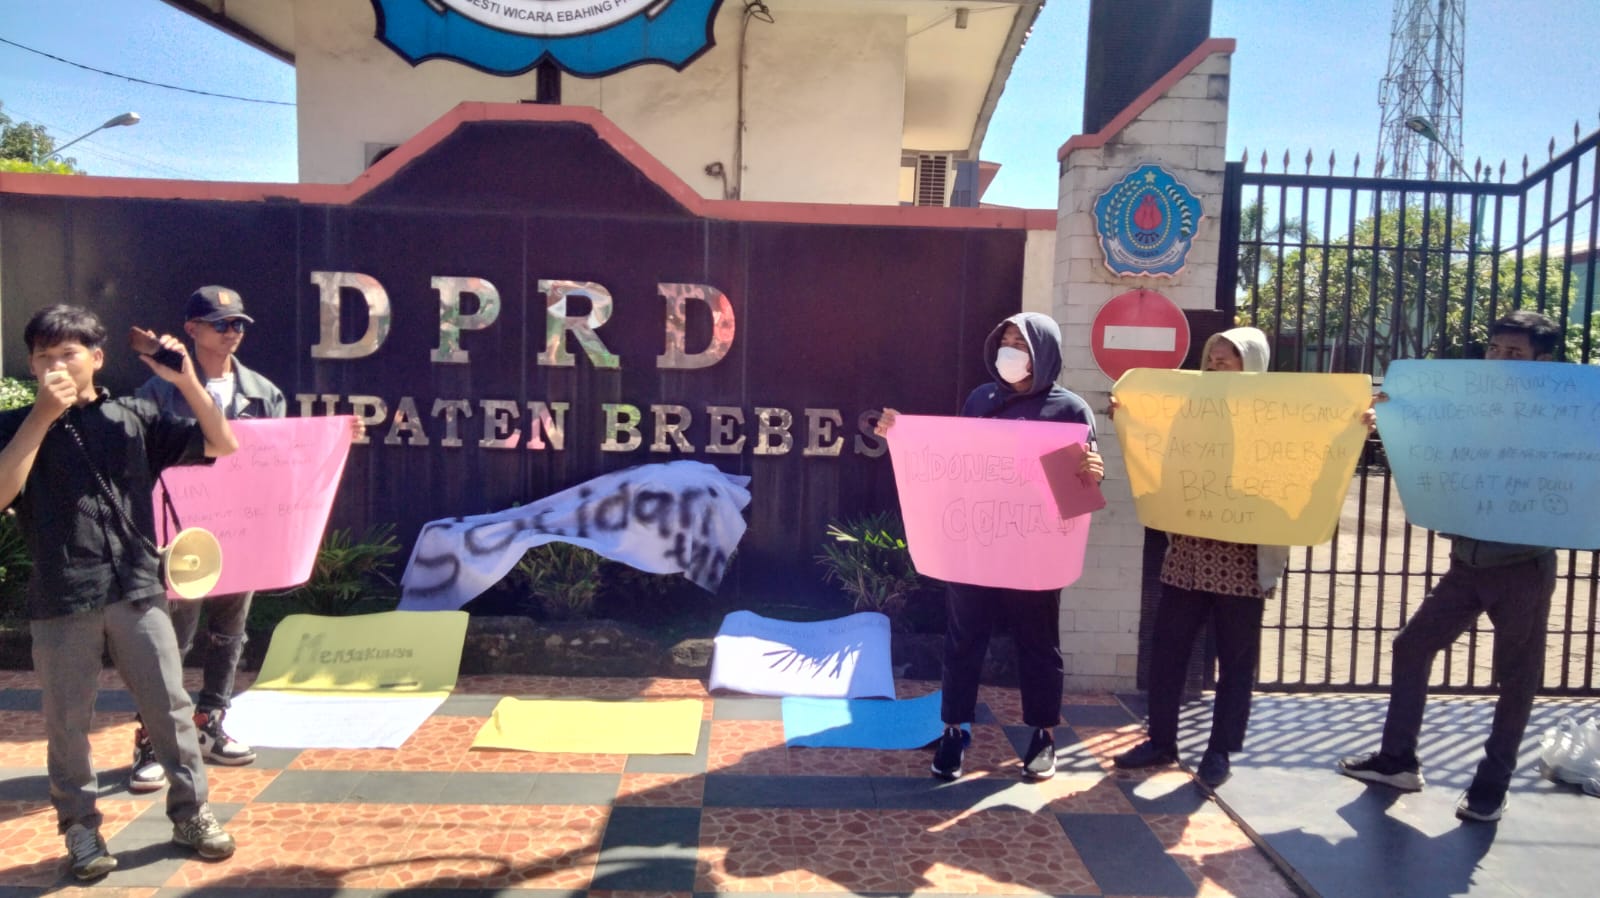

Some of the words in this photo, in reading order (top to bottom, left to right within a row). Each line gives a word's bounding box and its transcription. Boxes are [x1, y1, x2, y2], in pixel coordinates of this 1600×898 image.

[466, 0, 500, 14] ESTI
[503, 5, 553, 22] WICARA
[557, 1, 612, 22] EBAHING
[310, 271, 736, 369] DPRD
[1394, 370, 1454, 394] DPR
[1139, 393, 1240, 420] DEWAN
[600, 404, 888, 458] BREBES
[1144, 432, 1232, 460] RAKYAT
[1254, 439, 1346, 462] DAERAH
[1220, 508, 1256, 524] OUT
